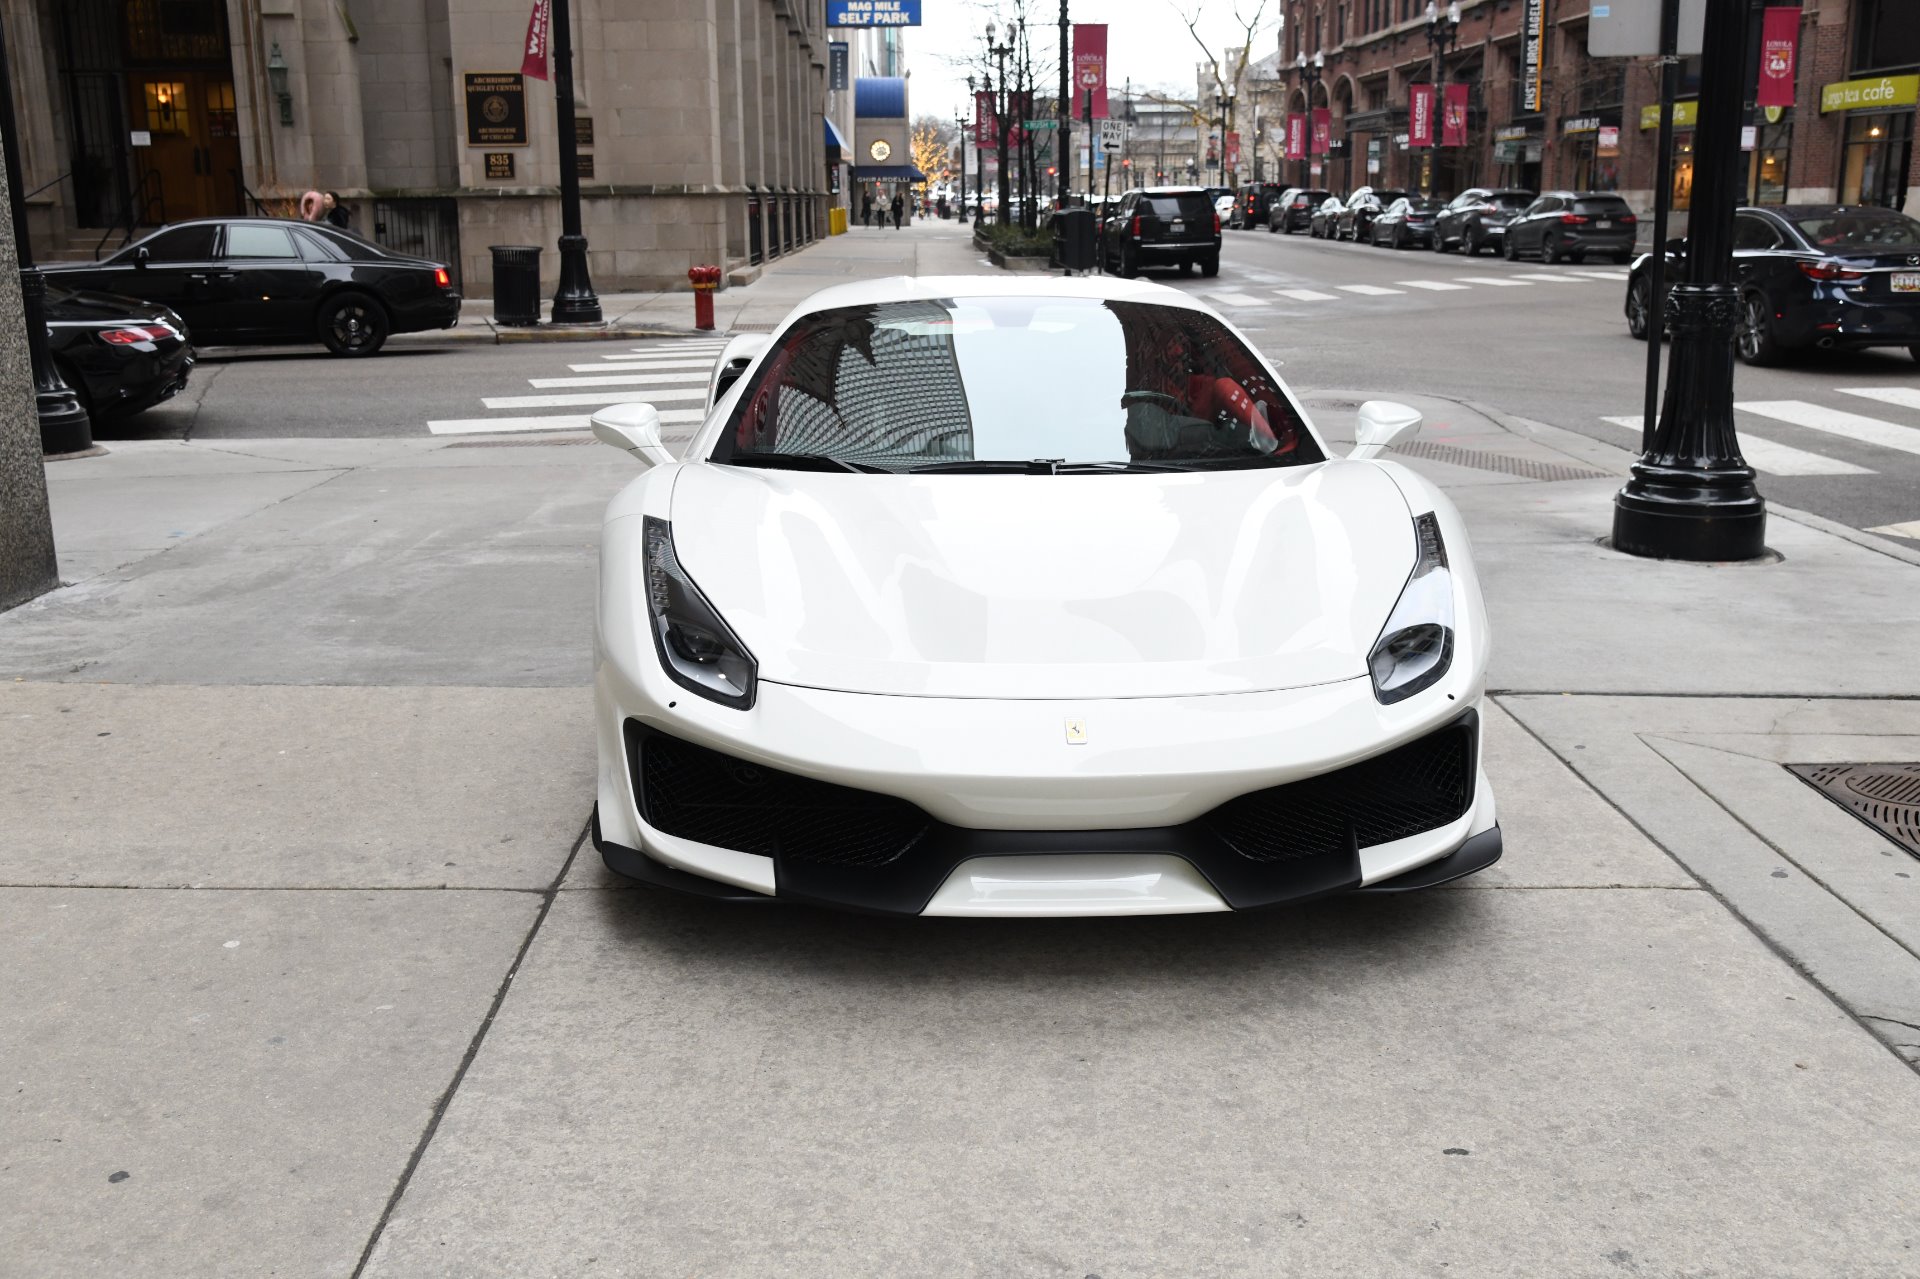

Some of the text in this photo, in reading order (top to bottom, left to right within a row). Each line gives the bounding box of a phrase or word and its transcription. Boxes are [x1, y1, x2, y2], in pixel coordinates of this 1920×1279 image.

[847, 1, 901, 11] MAG MILE
[838, 12, 910, 24] SELF PARK
[1528, 0, 1540, 36] BAGELS
[1766, 40, 1793, 48] LOYOLA
[1076, 54, 1103, 62] LOYOLA
[496, 84, 522, 92] CENTER
[1524, 65, 1538, 110] EINSTEIN
[1862, 78, 1895, 100] café
[1415, 92, 1423, 139] WELCOME
[1102, 121, 1122, 131] ONE
[1102, 132, 1122, 140] WAY
[489, 154, 510, 166] 835
